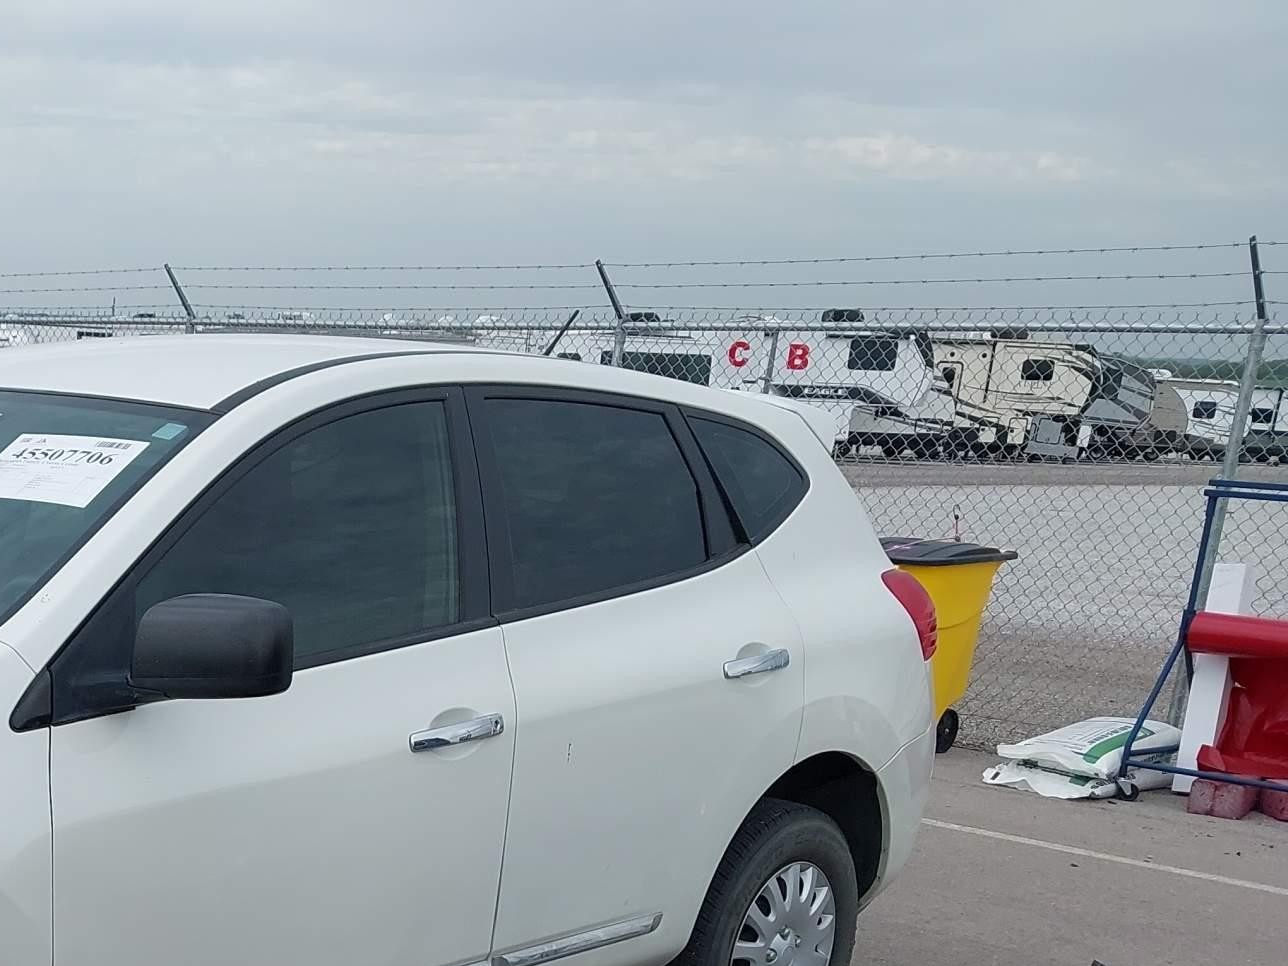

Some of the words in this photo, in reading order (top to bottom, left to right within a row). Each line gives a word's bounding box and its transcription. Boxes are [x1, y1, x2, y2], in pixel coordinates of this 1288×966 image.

[728, 341, 750, 367] C
[787, 343, 809, 370] B
[803, 387, 847, 395] EAGLE
[12, 447, 116, 466] 45507706
